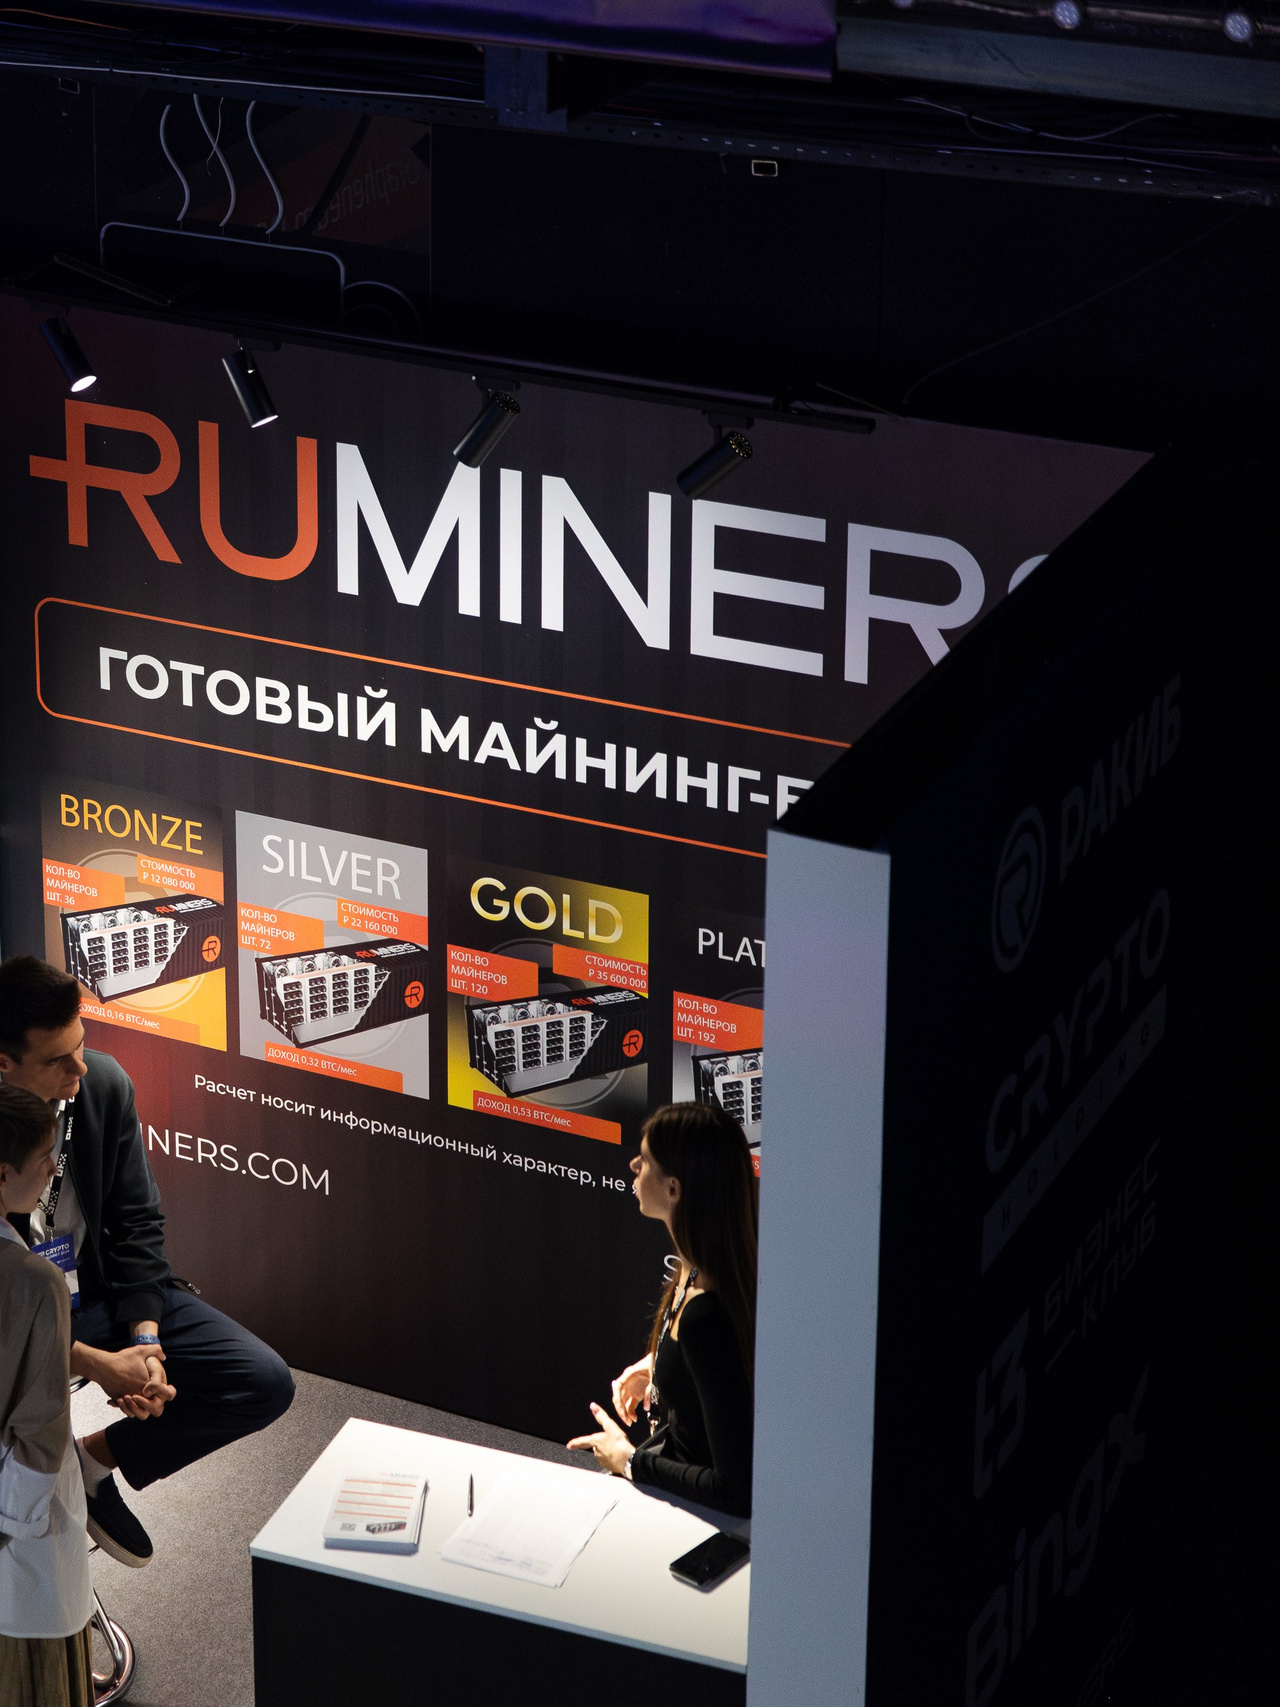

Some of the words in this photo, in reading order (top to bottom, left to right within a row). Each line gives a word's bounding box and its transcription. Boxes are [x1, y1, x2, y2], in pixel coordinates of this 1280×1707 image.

[29, 398, 1052, 686] RUMINER
[97, 646, 399, 749] ГОТОВЫЙ
[60, 793, 204, 855] BRONZE
[45, 864, 81, 880] КОЛ-ВО
[140, 859, 196, 879] СТОИМОСТЬ
[261, 833, 402, 900] SILVER
[46, 877, 98, 897] МАЙНЕРОВ
[151, 873, 161, 884] 12
[162, 876, 178, 888] 080
[179, 880, 196, 891] 000
[46, 891, 62, 903] ШТ.
[64, 895, 76, 905] 36
[240, 907, 277, 924] КОЛ-ВО
[340, 902, 399, 923] СТОИМОСТЬ
[470, 877, 624, 944] GOLD
[241, 920, 295, 942] МАЙНЕРОВ
[351, 917, 362, 928] 22
[364, 920, 380, 932] 160
[381, 923, 398, 935] 000
[241, 934, 258, 948] ШТ.
[260, 938, 271, 950] 72
[450, 950, 489, 967] КОЛ-ВО
[585, 954, 647, 976] СТОИМОСТЬ
[451, 964, 508, 985] МАЙНЕРОВ
[596, 970, 608, 981] 35
[610, 973, 628, 985] 600
[629, 976, 647, 989] 000
[451, 978, 468, 991] ШТ.
[470, 983, 488, 995] 120
[107, 1009, 124, 1020] 0,16
[677, 997, 718, 1015] КОЛ-ВО
[677, 1012, 737, 1034] МАЙНЕРОВ
[677, 1026, 695, 1039] ШТ.
[698, 1031, 716, 1043] 192
[267, 1047, 300, 1064] ДОХОД
[301, 1056, 320, 1068] 0,32
[477, 1097, 511, 1114] ДОХОД
[512, 1106, 532, 1117] 0,53
[194, 1074, 256, 1102] Расчет
[261, 1093, 315, 1117] носит
[320, 1107, 497, 1161] информационный
[502, 1151, 596, 1187] характер,
[602, 1175, 626, 1192] не
[45, 1243, 70, 1256] CRYPTO
